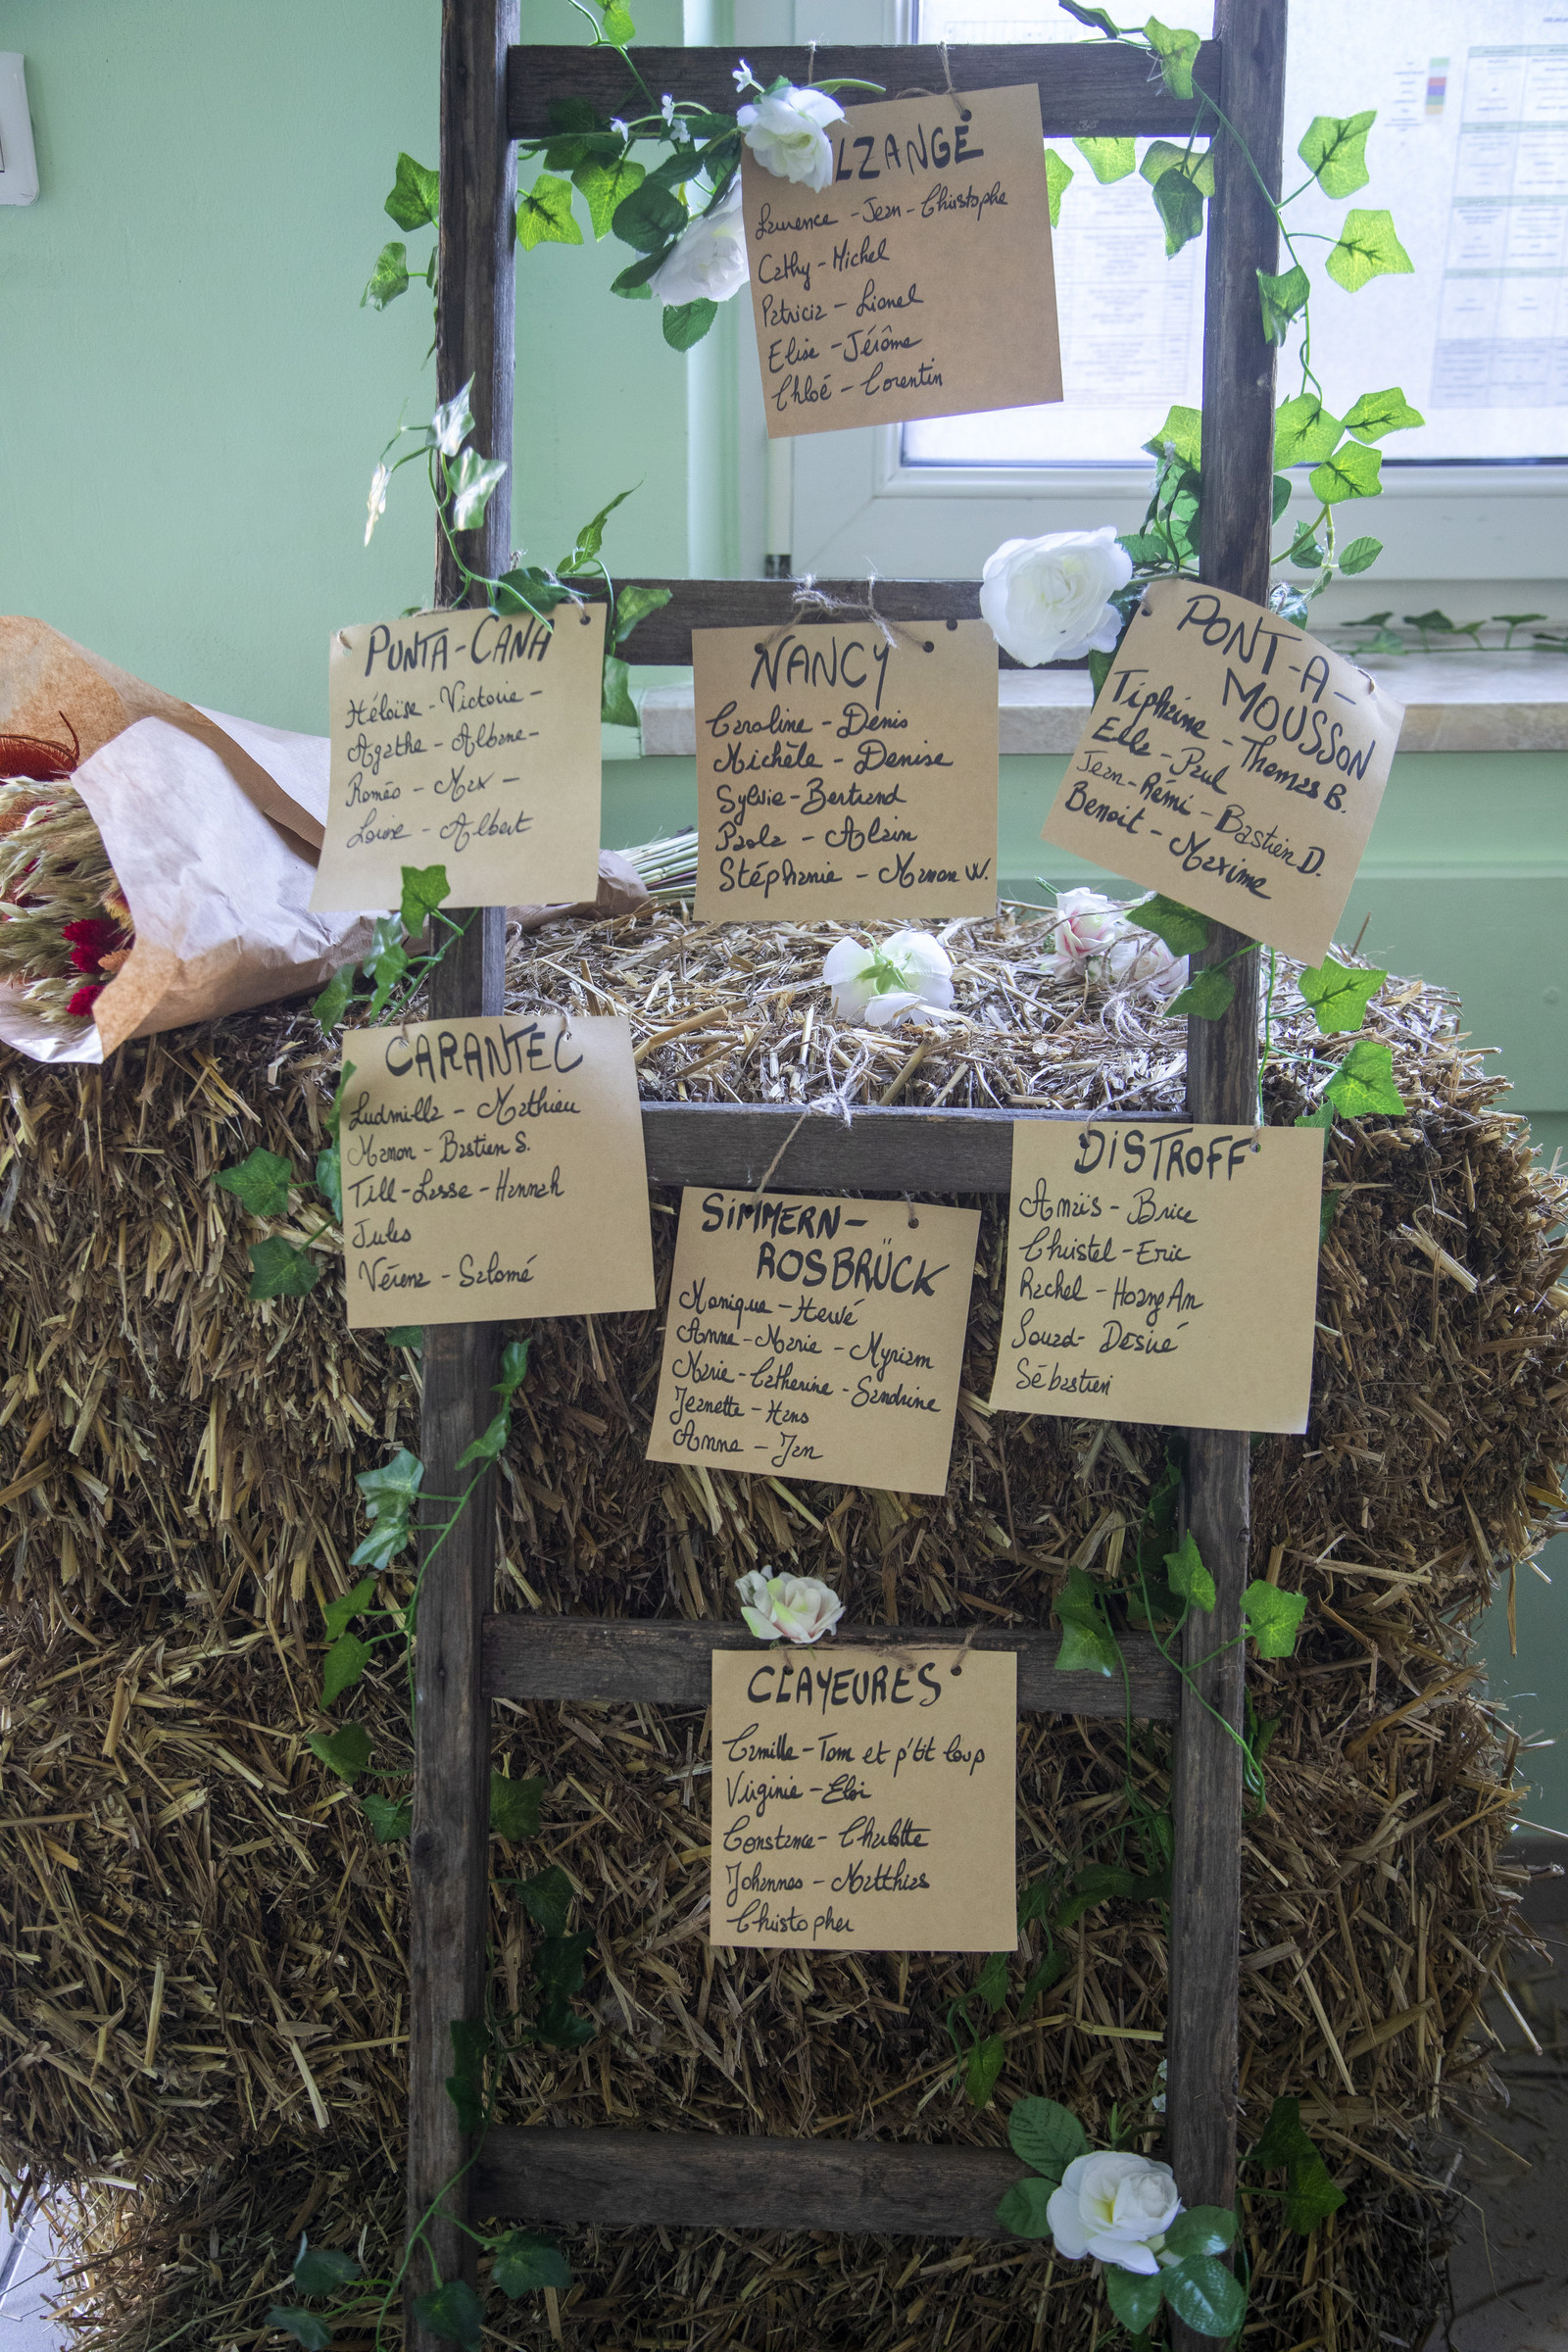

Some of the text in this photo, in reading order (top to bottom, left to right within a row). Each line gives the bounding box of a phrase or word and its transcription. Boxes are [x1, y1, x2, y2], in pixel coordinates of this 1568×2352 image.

[829, 122, 984, 183] LZANGE
[758, 250, 811, 291] Cathy
[832, 234, 890, 272] Michel
[762, 294, 827, 328] Patricia
[856, 278, 924, 318] Lionel
[768, 337, 819, 374] Elise
[771, 373, 832, 412] Chloé
[859, 357, 943, 396] Corentin
[750, 634, 893, 710] NANCY
[706, 700, 813, 738] Caroline
[836, 702, 908, 739] Denis
[1221, 666, 1377, 782] MOUSSON
[347, 731, 427, 775] Agathe
[713, 741, 823, 775] Michèle
[854, 738, 954, 775] Denise
[1168, 746, 1231, 796] Paul
[1240, 734, 1319, 801] Thomas
[345, 770, 401, 808] Roméo
[346, 807, 413, 849] Louise
[714, 820, 787, 852] Paola
[824, 815, 918, 852] Alain
[718, 856, 843, 899] Stéphanie
[878, 851, 960, 889] Manon
[1169, 830, 1273, 901] Maxime
[384, 1022, 584, 1084] CARANTEC
[348, 1090, 444, 1132] Ludmilla
[476, 1083, 581, 1126] Mathieu
[347, 1133, 416, 1167] Manon
[439, 1129, 511, 1163] Bastien
[495, 1164, 565, 1202] Hannah
[1018, 1177, 1102, 1222] Anaïs
[1126, 1187, 1199, 1226] Brice
[351, 1217, 412, 1249] Jules
[1018, 1225, 1117, 1264] Christel
[1136, 1239, 1192, 1265] Eric
[458, 1250, 538, 1288] Salomé
[757, 1238, 951, 1298] ROSBRÜCK
[1019, 1266, 1088, 1302] Rachel
[678, 1276, 774, 1331] Monique
[850, 1330, 935, 1383] Myriam
[1015, 1356, 1113, 1396] Sébastien
[765, 1398, 809, 1426] Hans
[851, 1374, 941, 1413] Sandrine
[770, 1431, 824, 1468] Jan
[747, 1661, 942, 1715] CLAYEURES
[721, 1722, 800, 1763] Camille
[818, 1732, 856, 1763] Tom
[862, 1740, 891, 1765] et
[942, 1734, 986, 1777] loup
[726, 1770, 804, 1817] Virginie
[820, 1773, 872, 1805] Eloi
[722, 1814, 816, 1855] Constance
[838, 1815, 932, 1848] Charlotte
[725, 1860, 804, 1908] Johannes
[831, 1858, 931, 1894] Matthias
